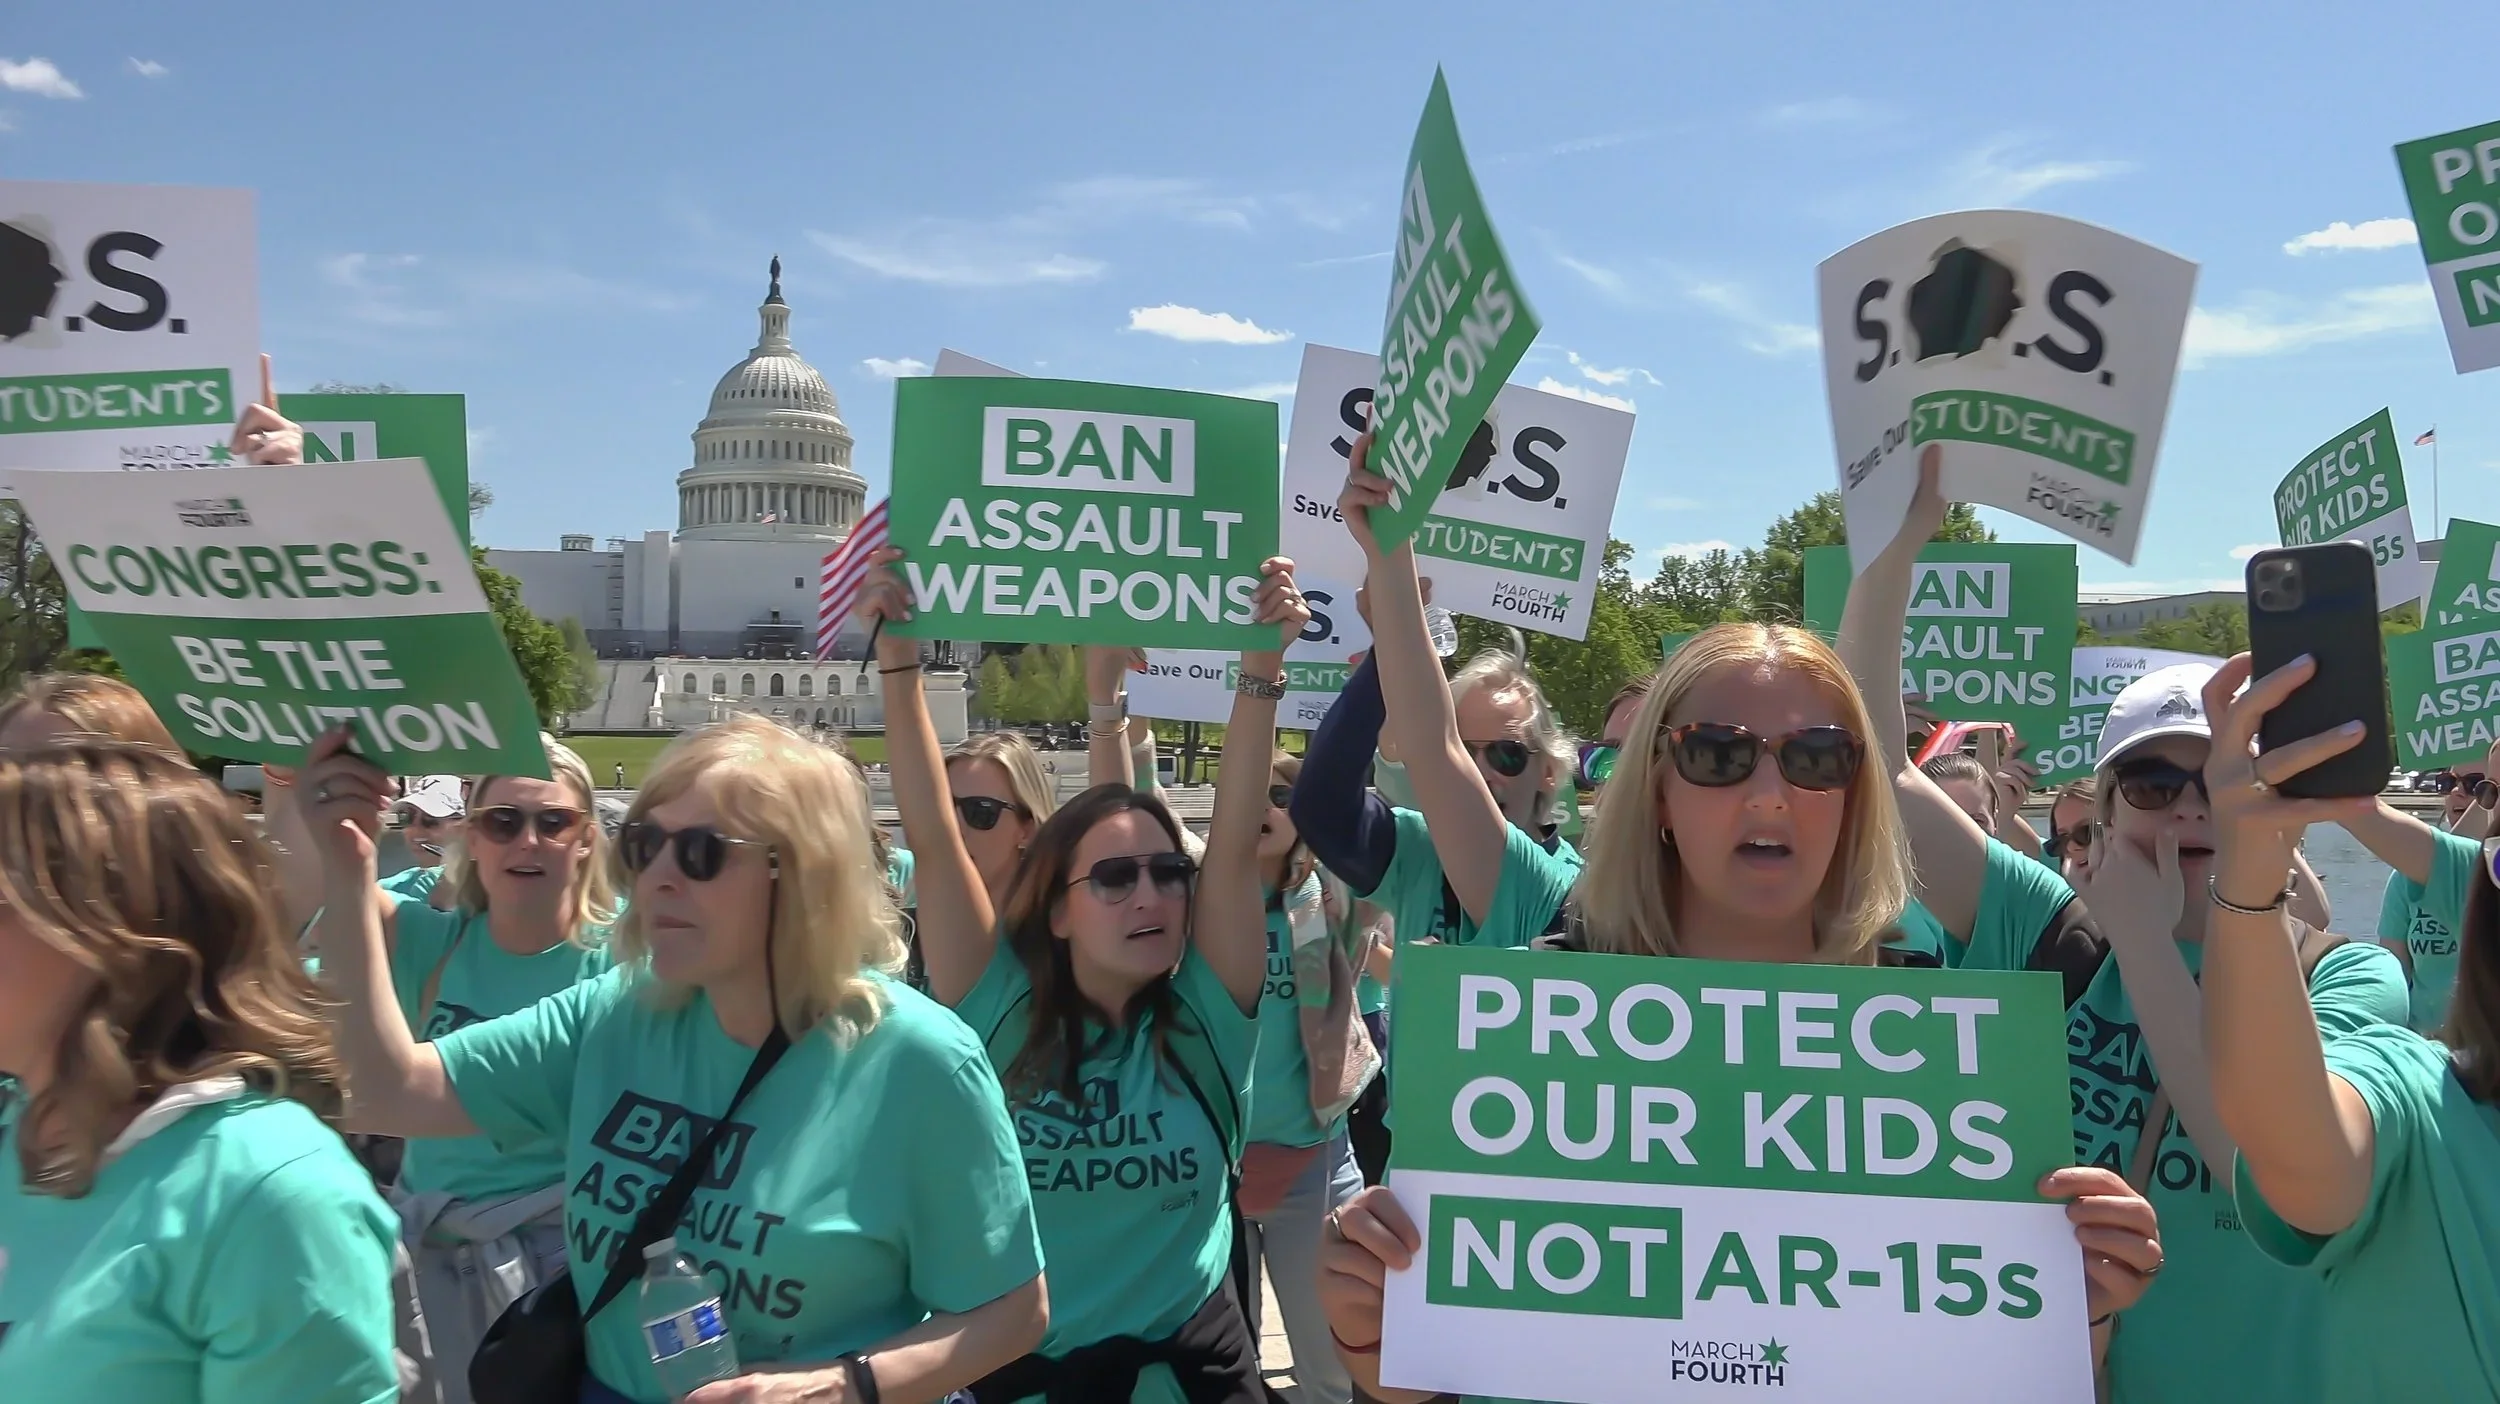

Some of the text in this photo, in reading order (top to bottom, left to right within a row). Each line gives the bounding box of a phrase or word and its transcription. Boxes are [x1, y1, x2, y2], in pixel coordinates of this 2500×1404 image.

[1381, 268, 1515, 513] WEAPONS
[1004, 417, 1173, 484] BAN
[1847, 399, 2126, 490] Save Our STUDENTS
[2278, 428, 2377, 529] PROTECT
[2318, 474, 2389, 536] KIDS
[927, 498, 1243, 560] ASSAULT
[2027, 487, 2114, 538] FOURTH
[68, 540, 443, 599] CONGRESS:
[1411, 521, 1575, 573] TUDENTS
[905, 562, 1259, 625] WEAPONS
[1492, 594, 1567, 623] FOURTH
[1495, 581, 1550, 603] MARCH
[1910, 569, 1994, 609] AN
[171, 635, 406, 691] BE THE
[1901, 625, 2044, 661] SAULT
[1188, 664, 1223, 680] Our
[1456, 973, 2000, 1076] PROTECT
[1018, 1110, 1164, 1150] SSAULT
[1451, 1075, 2015, 1181] OUR KIDS
[1026, 1147, 1199, 1192] EAPONS
[1451, 1216, 2044, 1320] NOT AR-15s
[1671, 1339, 1753, 1361] MARCH
[1671, 1359, 1784, 1387] FOURTH
